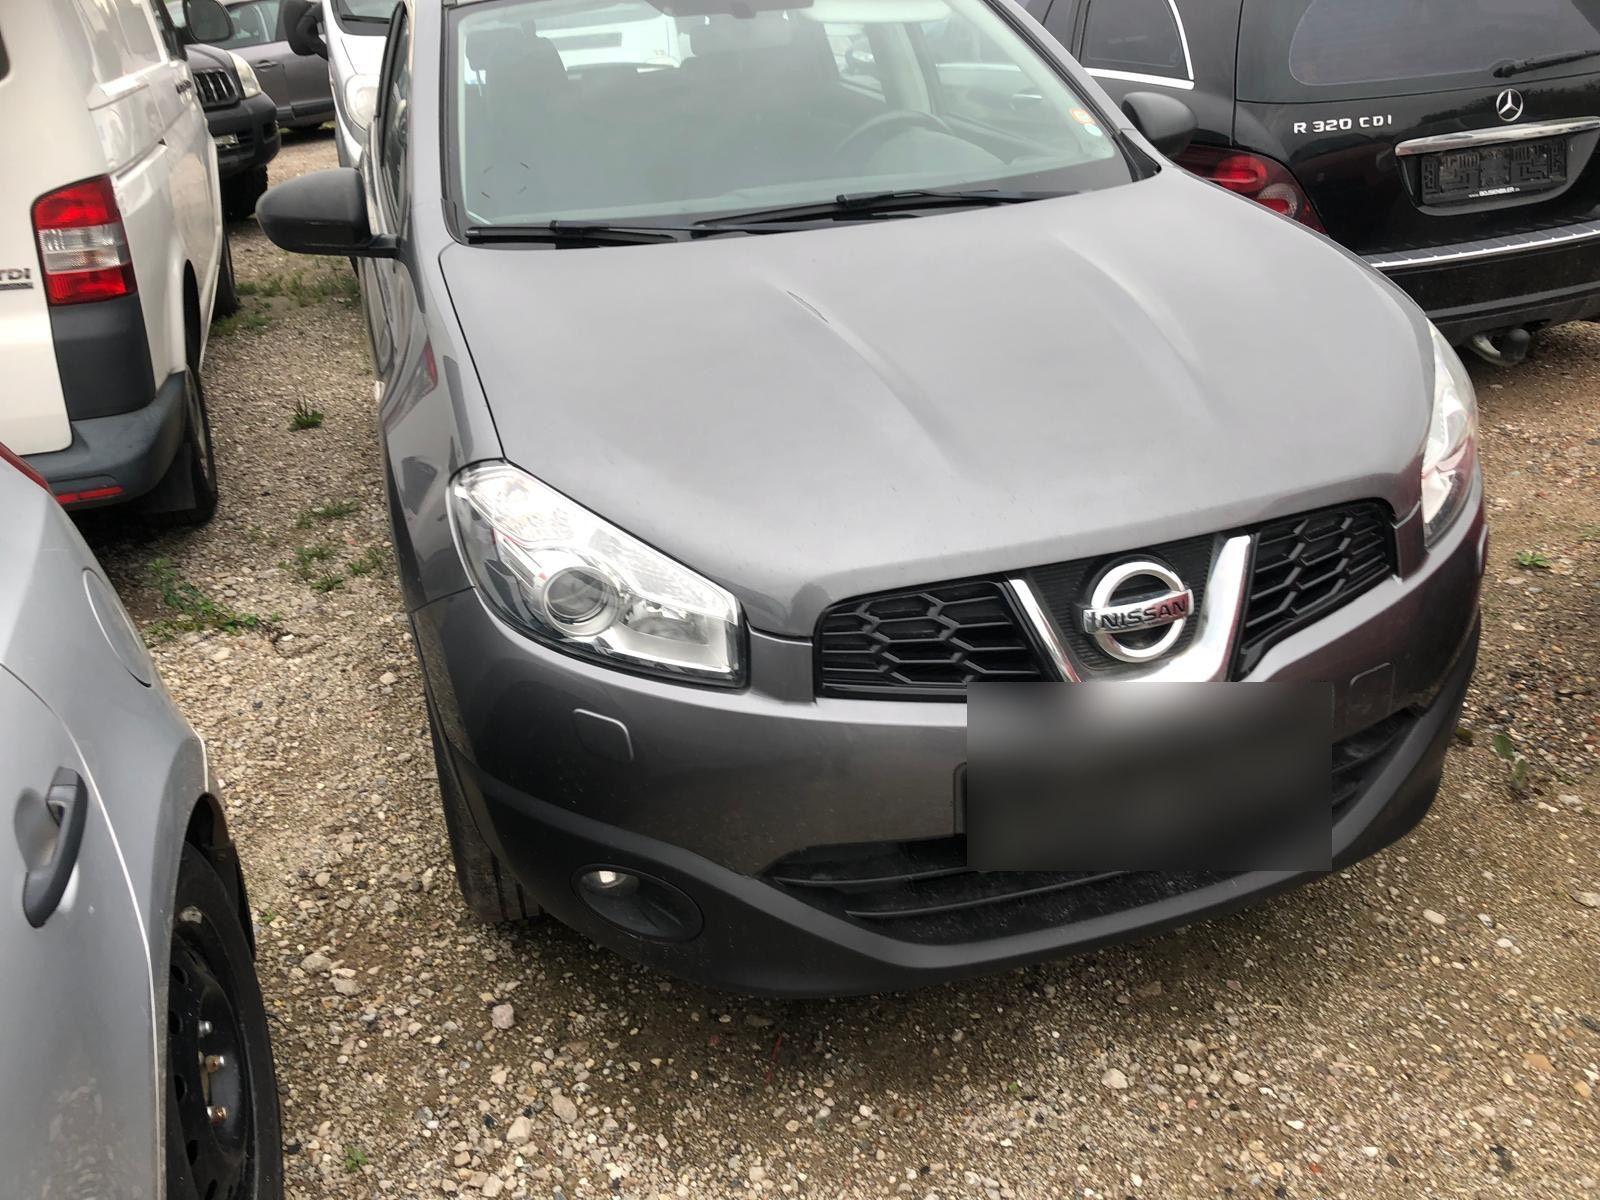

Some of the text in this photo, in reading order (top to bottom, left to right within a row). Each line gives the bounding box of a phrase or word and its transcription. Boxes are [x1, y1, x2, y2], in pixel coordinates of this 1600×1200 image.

[1293, 114, 1392, 134] R 320 CDI
[1100, 597, 1187, 629] NISSAN
